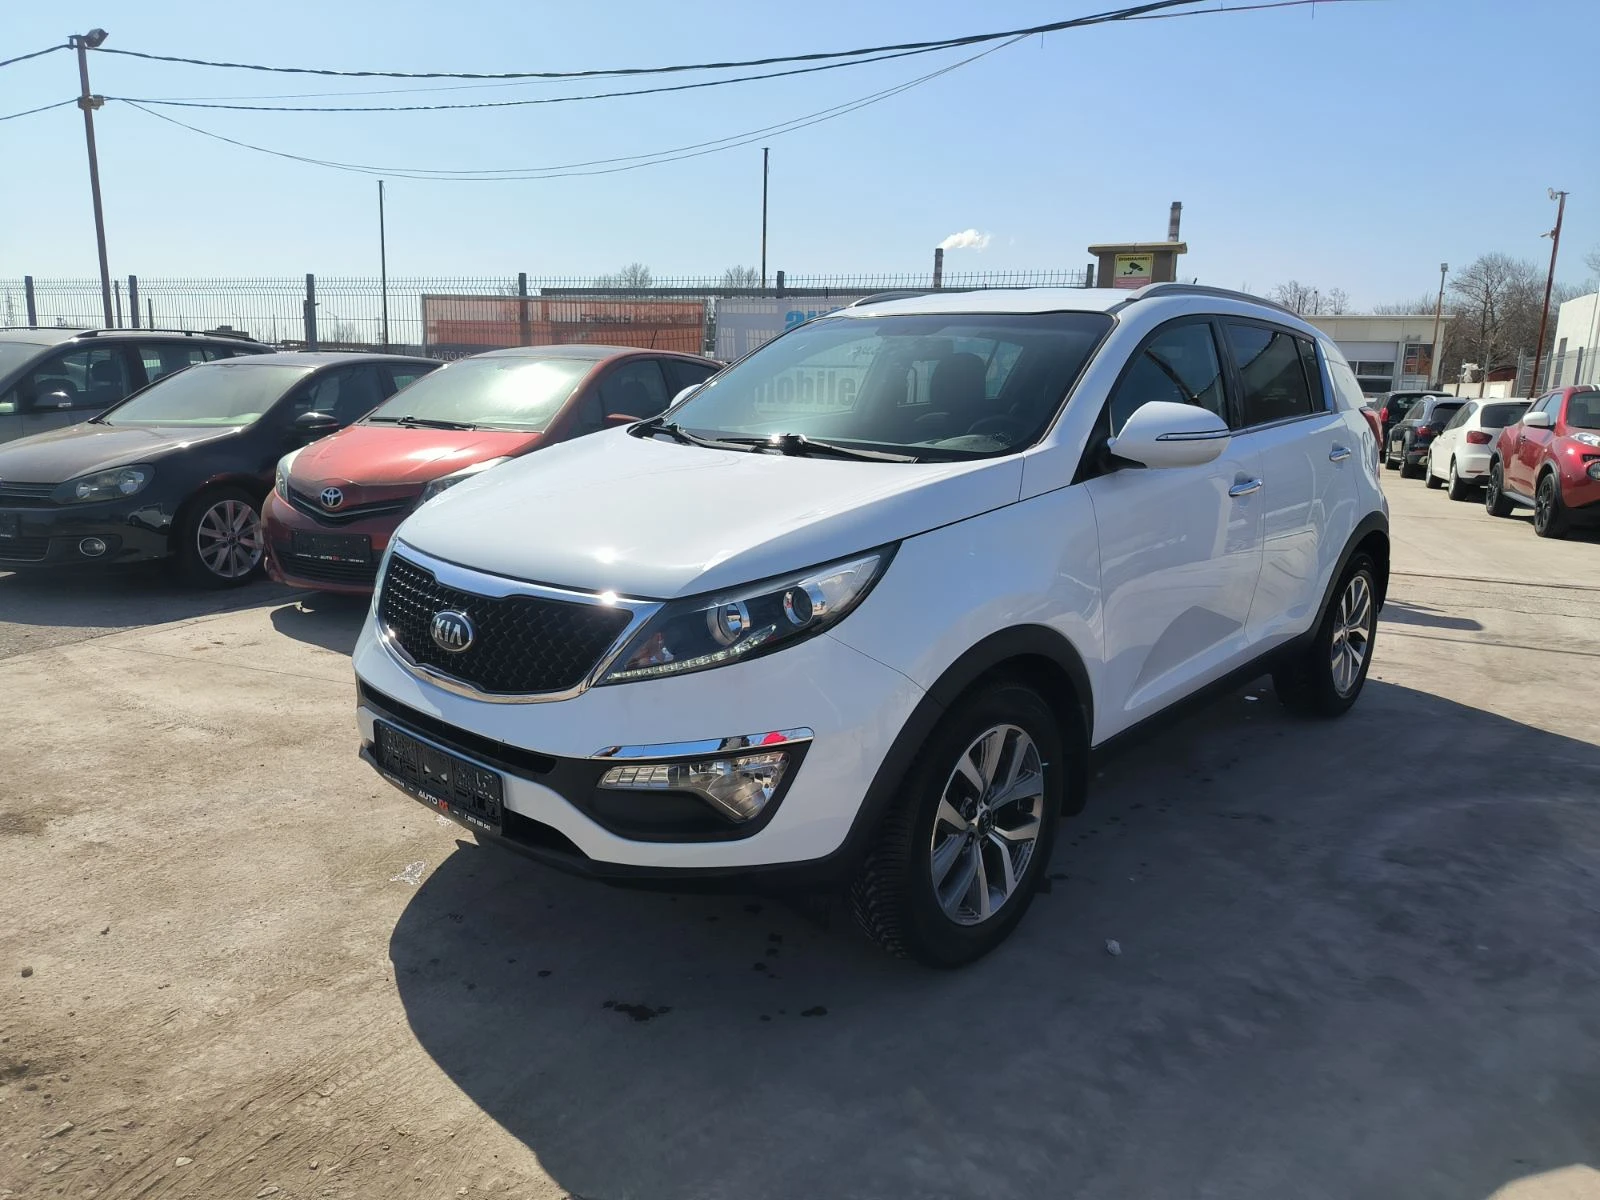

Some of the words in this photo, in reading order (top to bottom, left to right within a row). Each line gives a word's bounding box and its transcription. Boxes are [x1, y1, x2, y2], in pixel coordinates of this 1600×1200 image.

[432, 351, 457, 361] AUTO
[753, 370, 857, 406] mobile
[434, 617, 463, 646] KIA
[418, 790, 438, 805] AUTO
